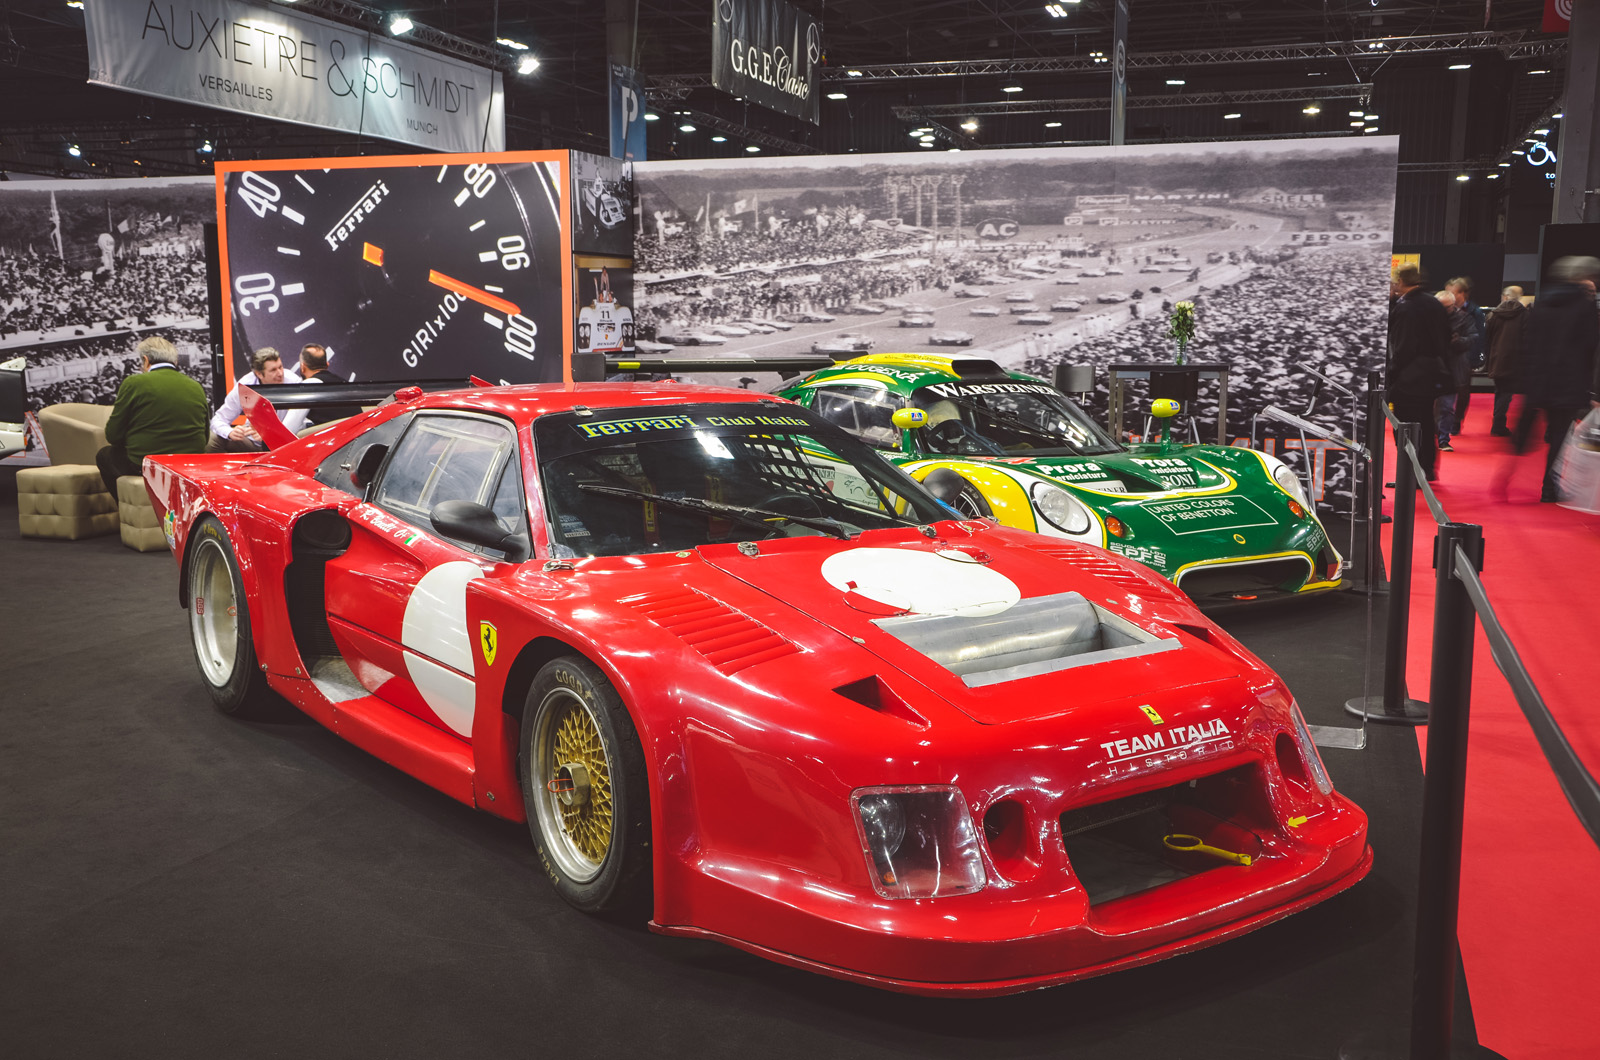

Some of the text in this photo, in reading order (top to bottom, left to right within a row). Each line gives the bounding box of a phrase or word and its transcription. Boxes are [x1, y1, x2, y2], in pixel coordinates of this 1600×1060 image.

[142, 2, 474, 116] AUXIETRE & SCHMIDT
[199, 73, 273, 101] VERSAILLES
[406, 118, 438, 136] MUNICH
[464, 164, 497, 198] 80
[237, 171, 281, 218] 40
[1134, 193, 1230, 201] MARTINI
[324, 179, 390, 251] Ferrari
[979, 223, 1016, 237] AC
[1291, 233, 1381, 242] FERODO
[497, 235, 531, 271] 90
[234, 272, 280, 317] 30
[601, 310, 610, 319] 11
[504, 313, 538, 361] 100
[925, 382, 1060, 398] WARSTEINER
[577, 414, 811, 438] Ferrari Club Italia
[1036, 462, 1102, 475] Prora
[1148, 498, 1235, 514] UNITED COLORS
[1160, 513, 1178, 522] OF
[1109, 545, 1167, 565] SPFS
[1100, 718, 1230, 759] TEAM ITALIA
[1108, 740, 1235, 776] HISTORIC
